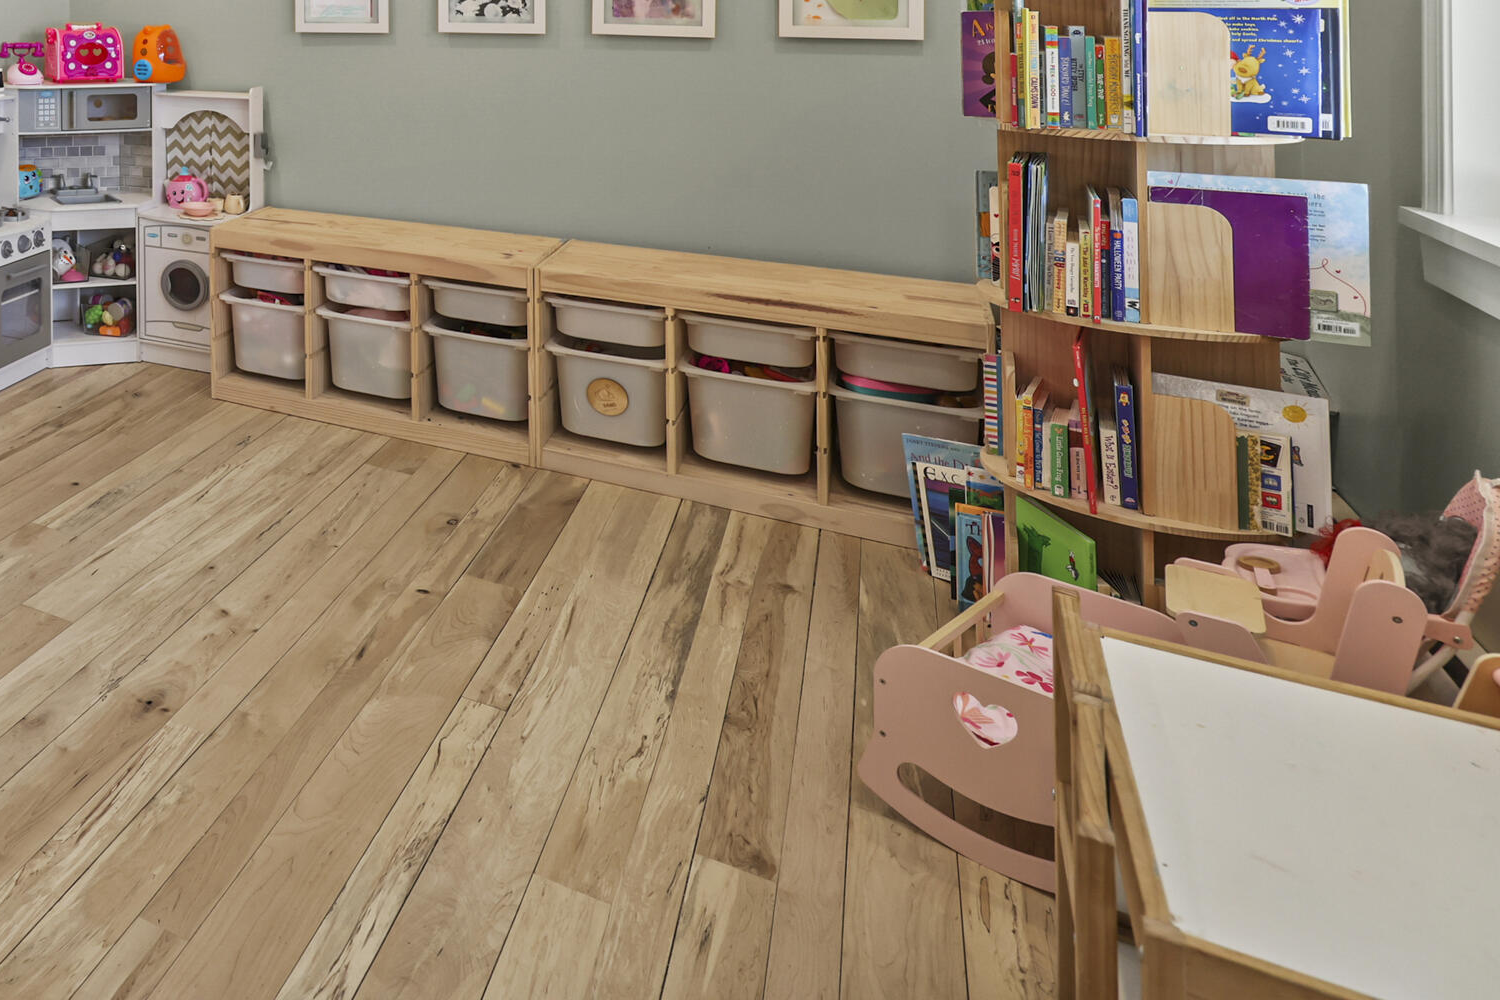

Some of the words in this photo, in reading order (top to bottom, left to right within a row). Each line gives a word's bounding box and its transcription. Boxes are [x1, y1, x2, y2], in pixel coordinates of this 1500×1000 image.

[1113, 239, 1122, 272] HALLOWEEN
[910, 452, 931, 464] And
[934, 456, 950, 467] the
